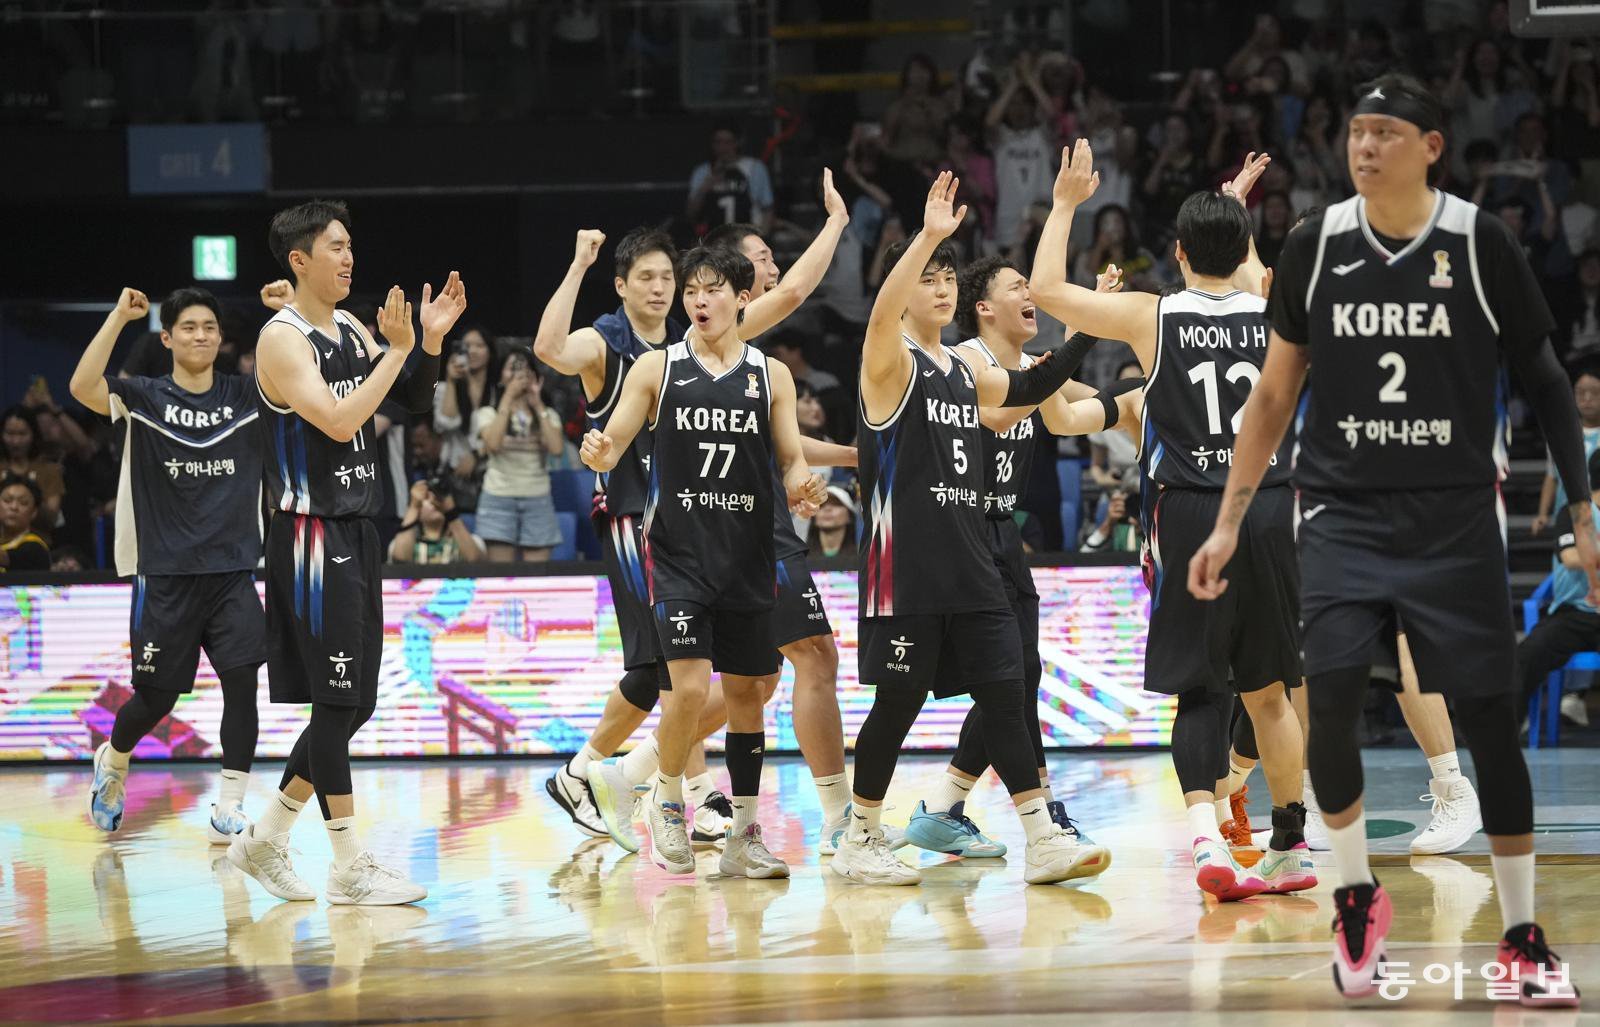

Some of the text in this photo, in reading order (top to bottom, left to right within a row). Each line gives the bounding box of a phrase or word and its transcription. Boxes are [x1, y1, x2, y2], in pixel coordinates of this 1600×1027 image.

[1332, 303, 1452, 337] KOREA
[1178, 325, 1232, 349] MOON
[1377, 352, 1408, 403] 2
[675, 407, 759, 434] KOREA
[927, 398, 980, 429] KOREA
[1364, 419, 1452, 446] 하나은행
[185, 459, 236, 477] 하나은행
[698, 442, 736, 479] 77
[953, 439, 968, 475] 5
[995, 450, 1015, 483] 36
[699, 491, 754, 512] 하나은행
